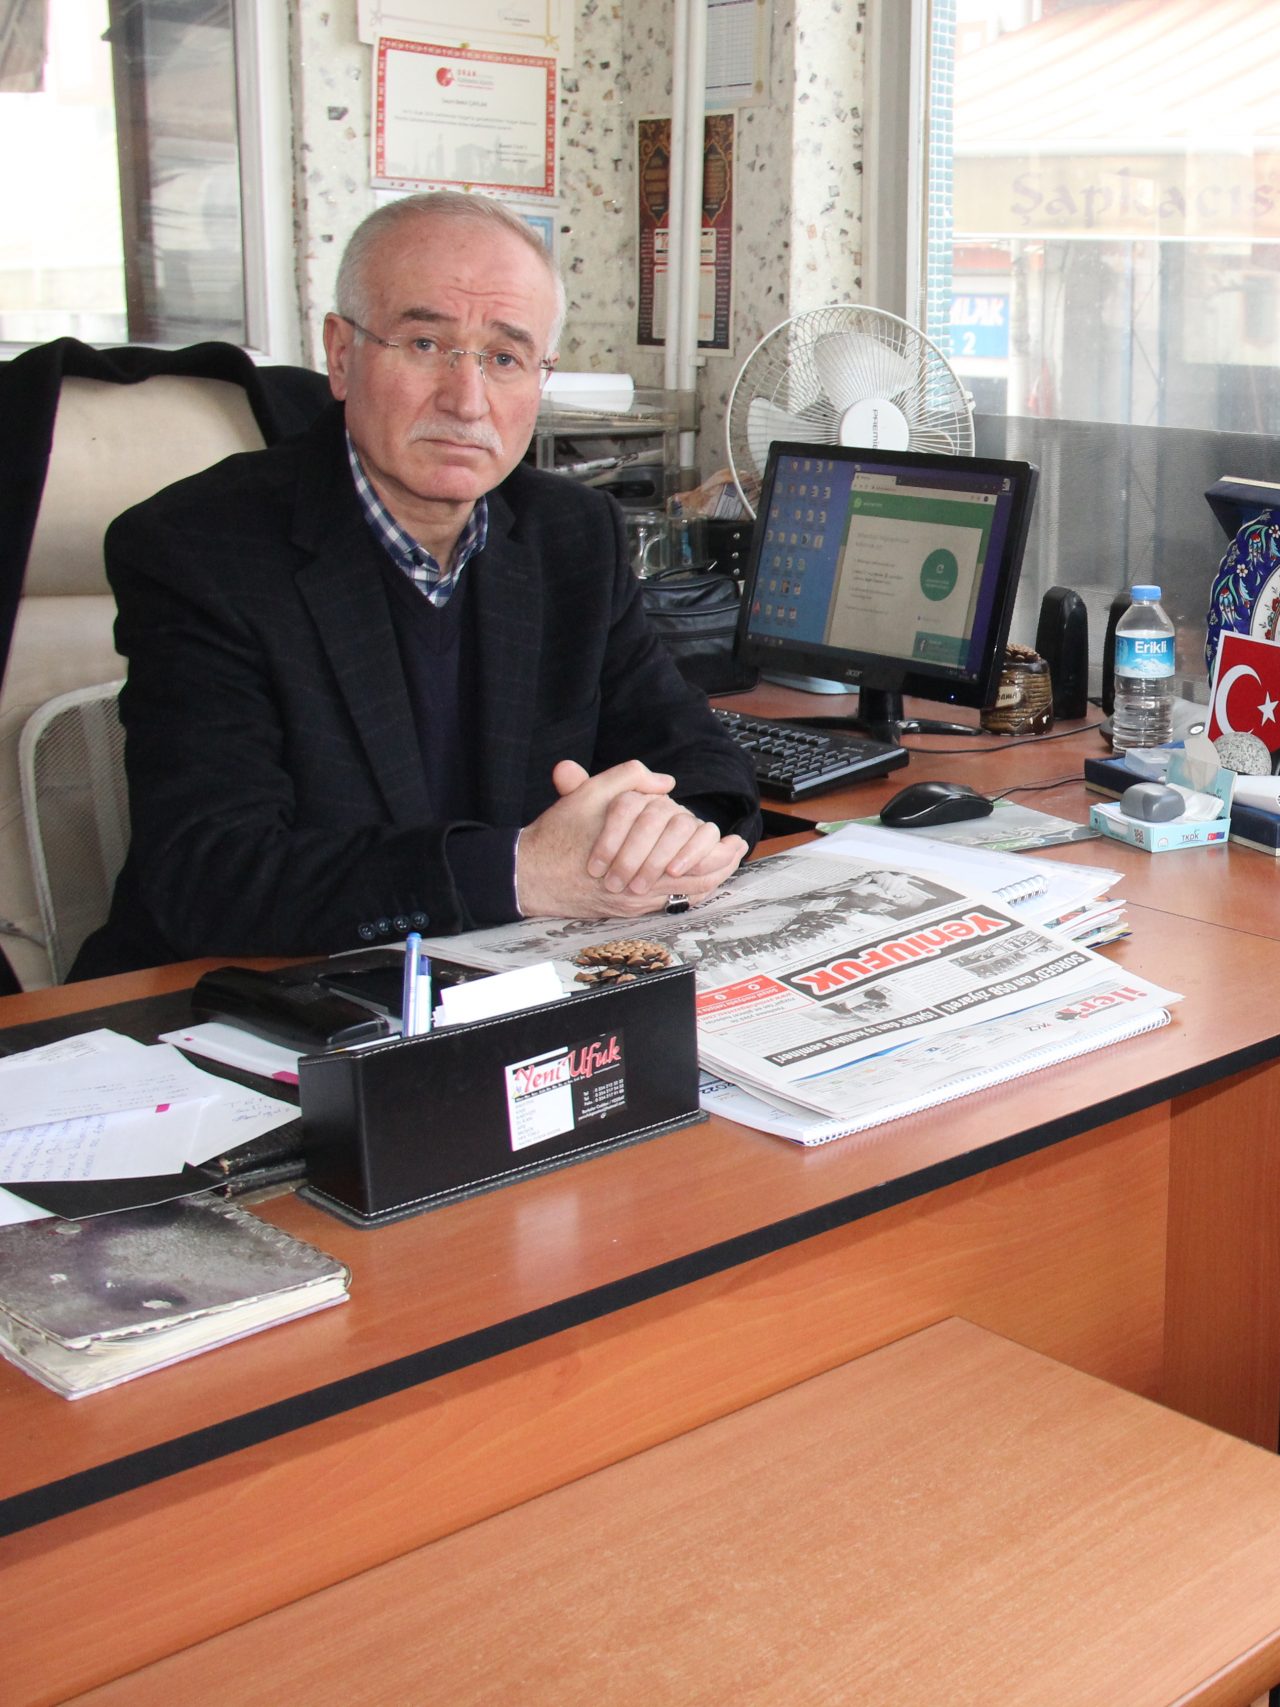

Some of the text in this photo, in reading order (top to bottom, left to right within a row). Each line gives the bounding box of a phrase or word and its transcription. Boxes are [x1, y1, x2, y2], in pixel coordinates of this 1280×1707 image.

[1135, 640, 1168, 654] Erikli
[515, 1036, 622, 1092] Yeni Ufuk
